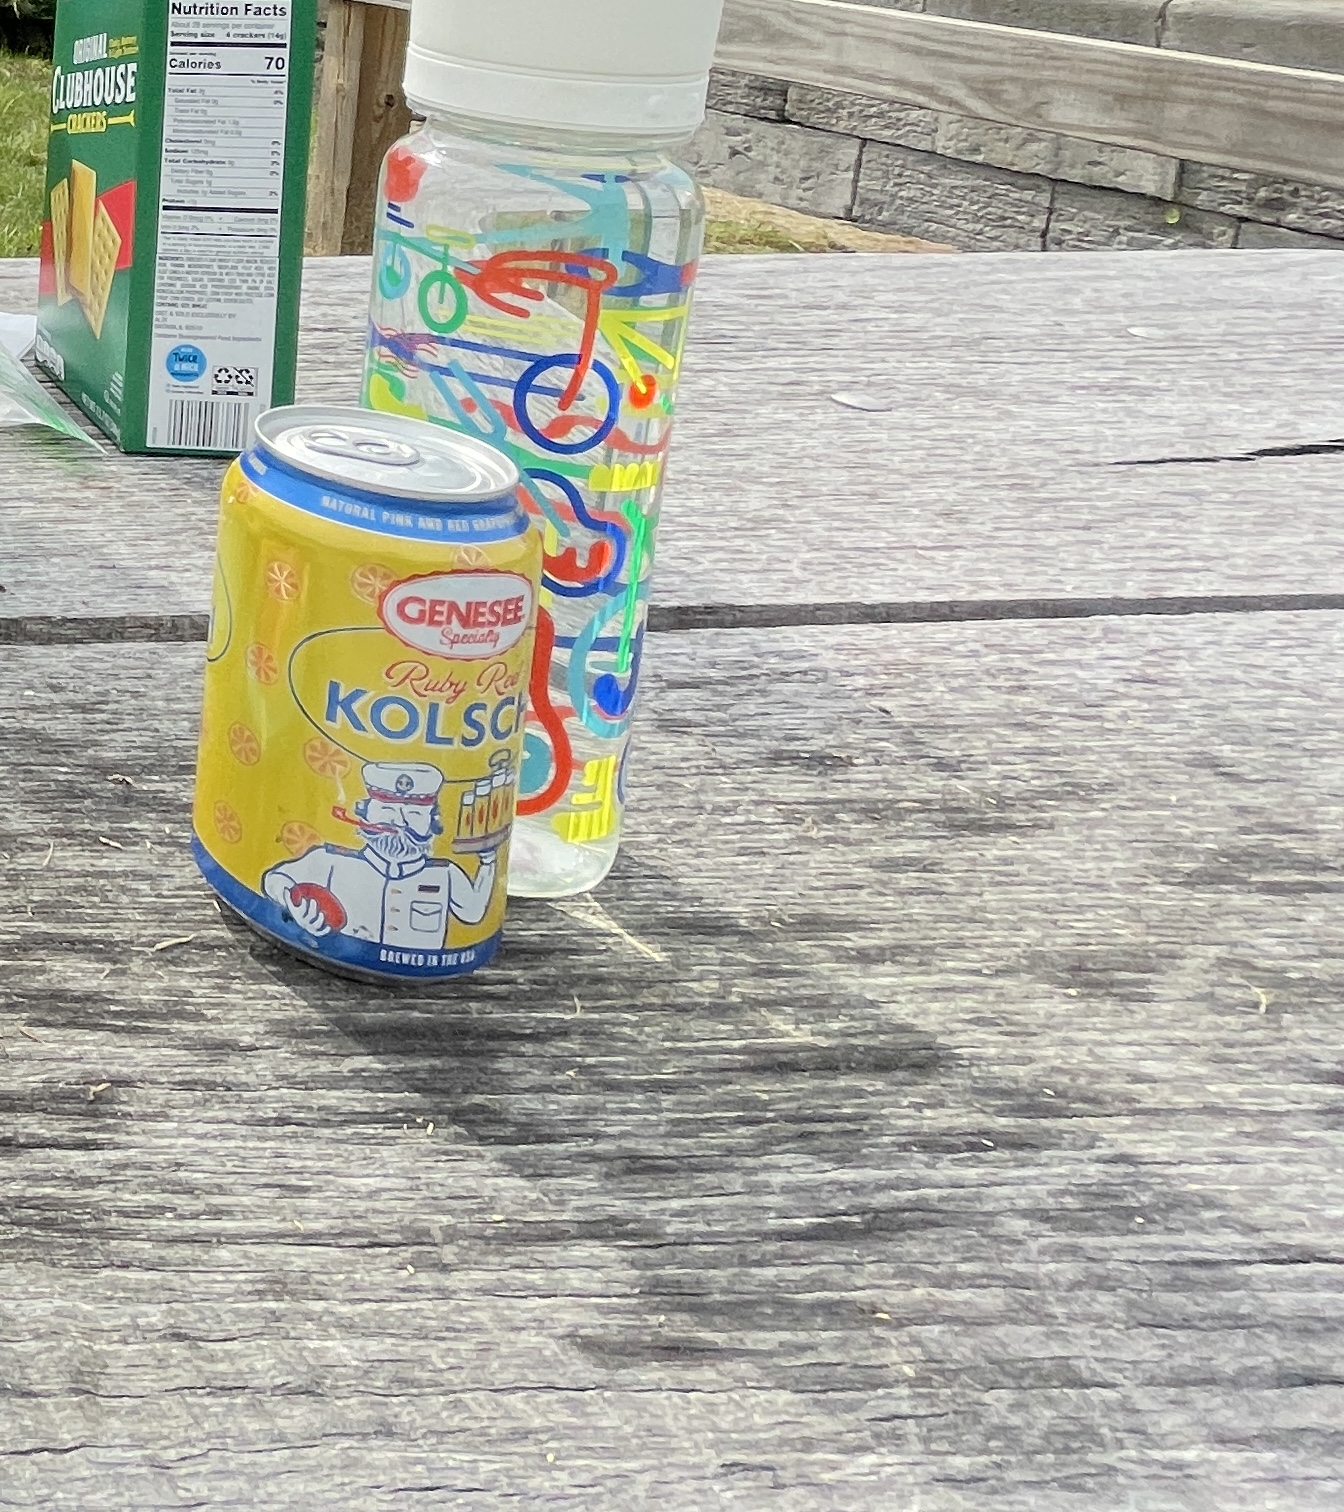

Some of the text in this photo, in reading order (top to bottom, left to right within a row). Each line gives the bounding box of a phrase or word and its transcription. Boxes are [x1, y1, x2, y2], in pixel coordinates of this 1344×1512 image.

[171, 1, 287, 17] Nutrition Facts
[169, 56, 285, 70] Calories 70
[52, 62, 138, 114] CLUBHOUSE
[67, 110, 107, 135] CRACKERS
[321, 495, 376, 521] NATURAL
[382, 511, 414, 528] PINK
[417, 517, 443, 532] AND
[396, 594, 526, 629] GENESEE
[439, 626, 500, 650] Specialty
[385, 660, 468, 705] Ruby
[379, 948, 425, 966] BREWED
[427, 954, 439, 966] IN
[441, 953, 459, 966] THE
